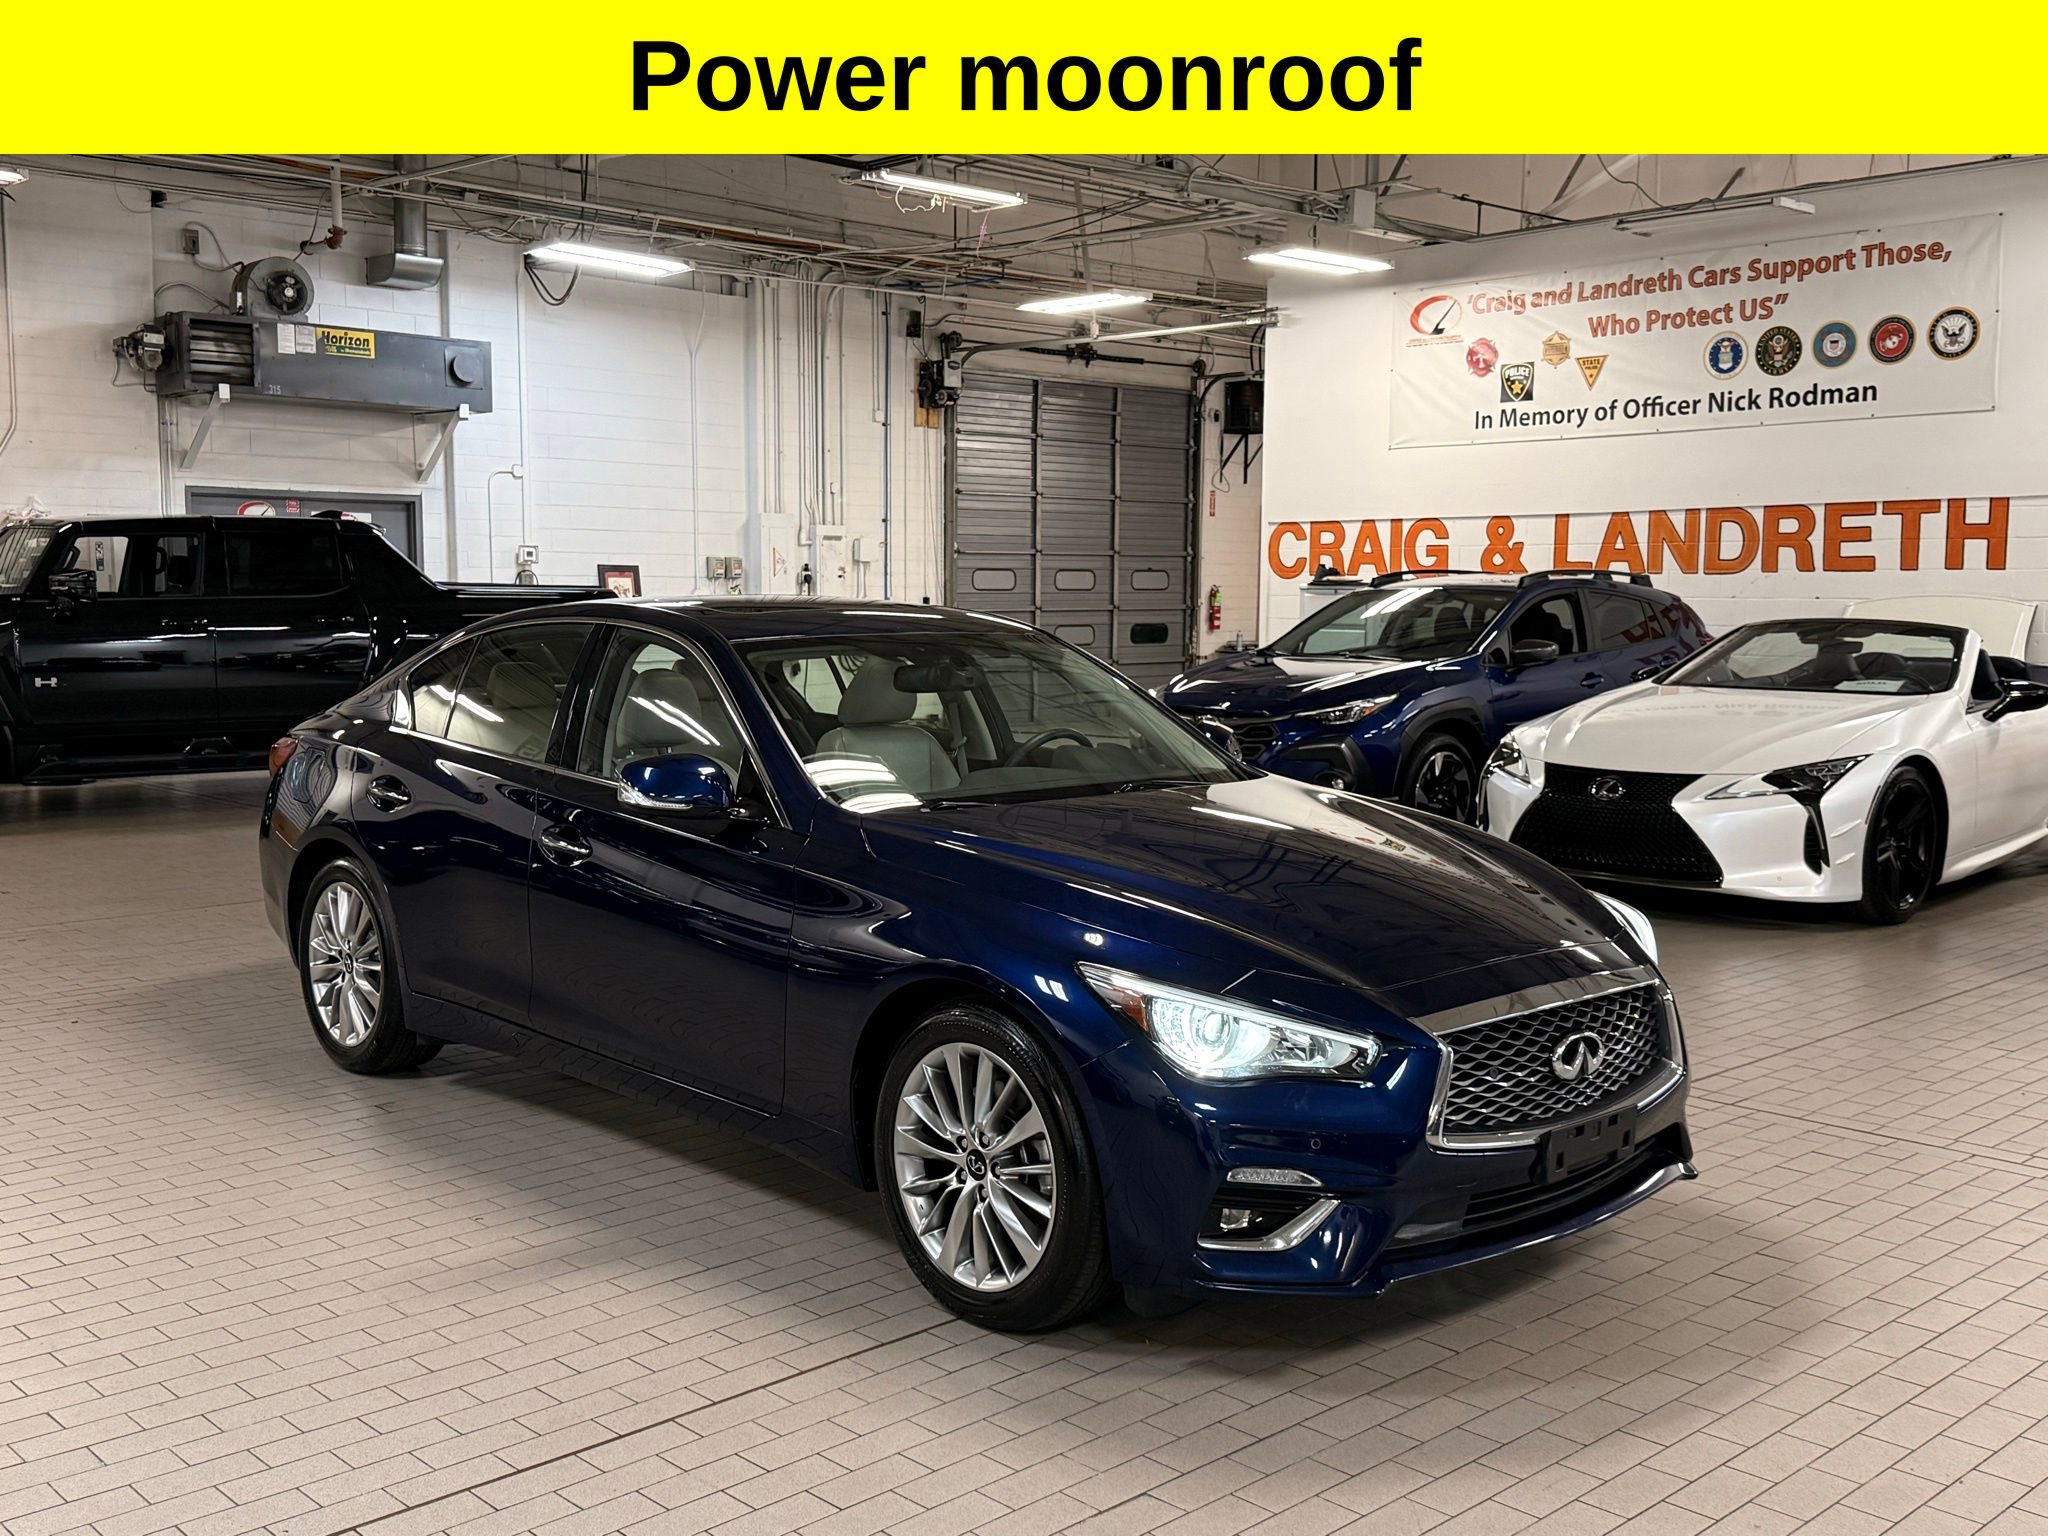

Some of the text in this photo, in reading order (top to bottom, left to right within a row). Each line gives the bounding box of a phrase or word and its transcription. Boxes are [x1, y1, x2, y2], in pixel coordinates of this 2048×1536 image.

[1531, 282, 1572, 309] and
[1578, 268, 1682, 302] Landreth
[1687, 264, 1742, 289] Cars
[1747, 249, 1856, 283] Support
[1861, 241, 1952, 268] Those,
[1588, 314, 1640, 338] Who
[1646, 303, 1733, 332] Protect
[322, 331, 370, 347] Horizon
[1504, 366, 1530, 379] POLICE
[1582, 358, 1600, 366] STATE
[1475, 383, 1878, 429] In Memory of Officer Nick Rodman
[1268, 497, 2010, 579] CRAIG & LANDRETH
